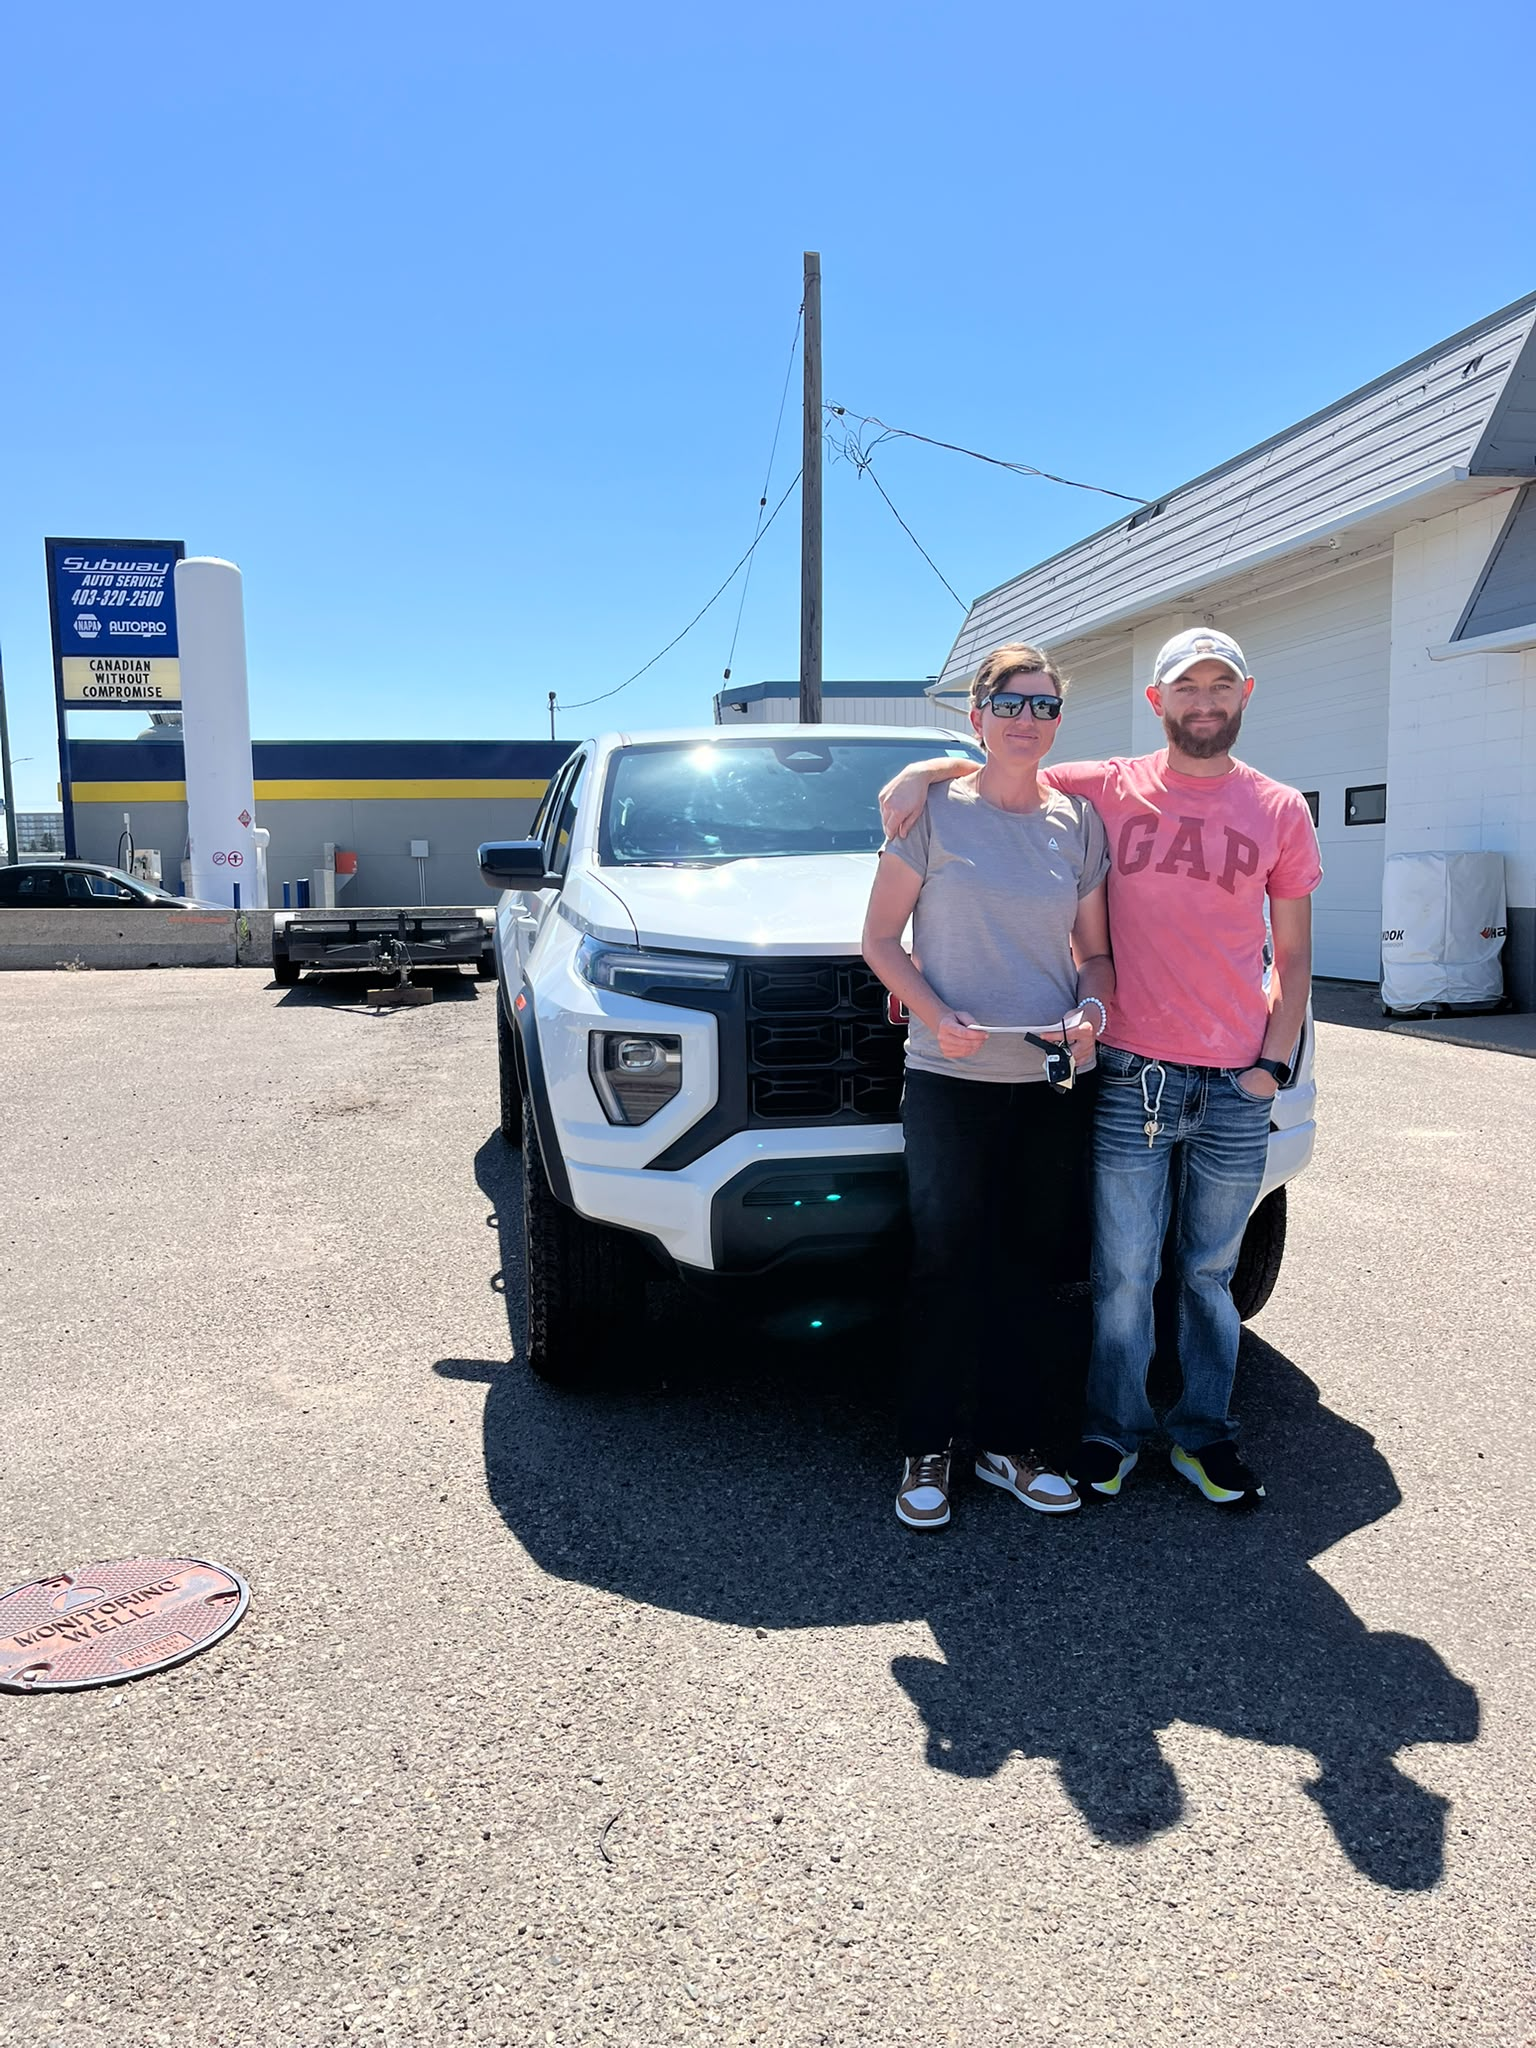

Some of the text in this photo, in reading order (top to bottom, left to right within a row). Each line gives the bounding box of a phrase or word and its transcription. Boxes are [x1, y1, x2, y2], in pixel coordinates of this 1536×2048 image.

[62, 557, 169, 575] Subway
[82, 574, 165, 588] AUTO SERVICE
[71, 589, 164, 607] 403-320-2500
[77, 620, 98, 632] NAPA
[109, 621, 166, 632] AUTOPRO
[89, 659, 151, 671] CANADIAN
[95, 673, 149, 684] WITHOUT
[82, 686, 162, 697] COMPROMISE
[1117, 813, 1259, 895] GAP
[13, 1580, 180, 1647] MONITORING
[62, 1608, 155, 1643] WELL
